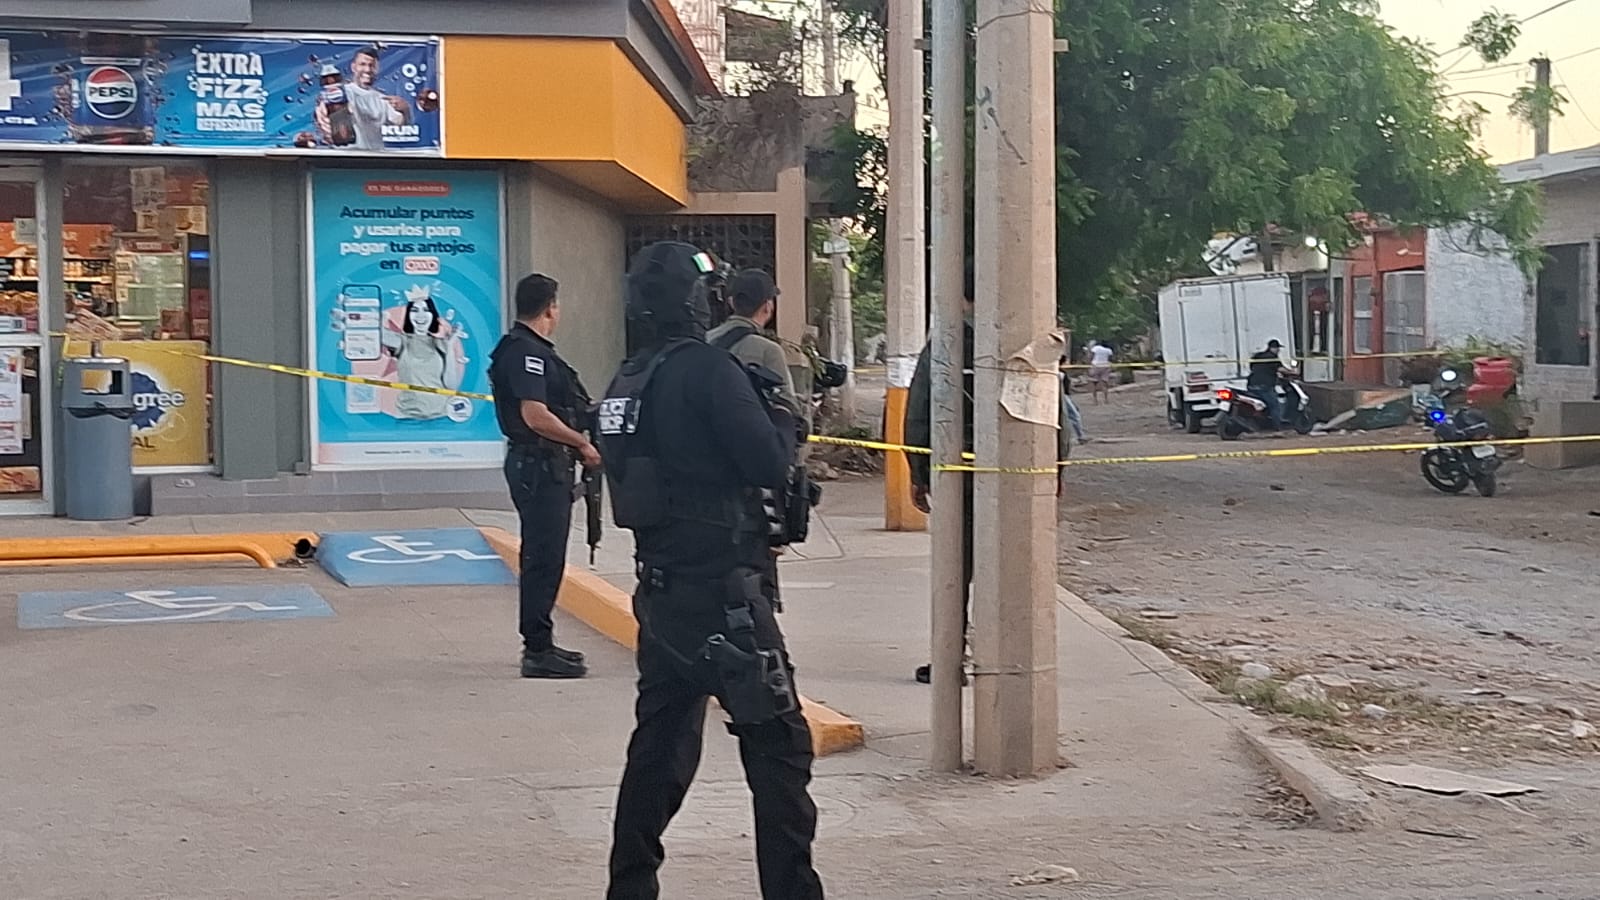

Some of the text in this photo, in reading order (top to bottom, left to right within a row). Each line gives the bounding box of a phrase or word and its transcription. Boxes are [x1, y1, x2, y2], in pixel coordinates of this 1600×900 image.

[196, 52, 264, 75] EXTRA
[88, 86, 134, 97] PEPSI
[196, 100, 265, 118] MÁS
[381, 125, 419, 135] KUN
[340, 206, 474, 221] Acumular puntos
[353, 224, 461, 239] y usarlos para
[340, 240, 474, 256] pagar tus antojos
[380, 260, 400, 270] en
[132, 392, 186, 411] gree
[131, 436, 156, 448] AL
